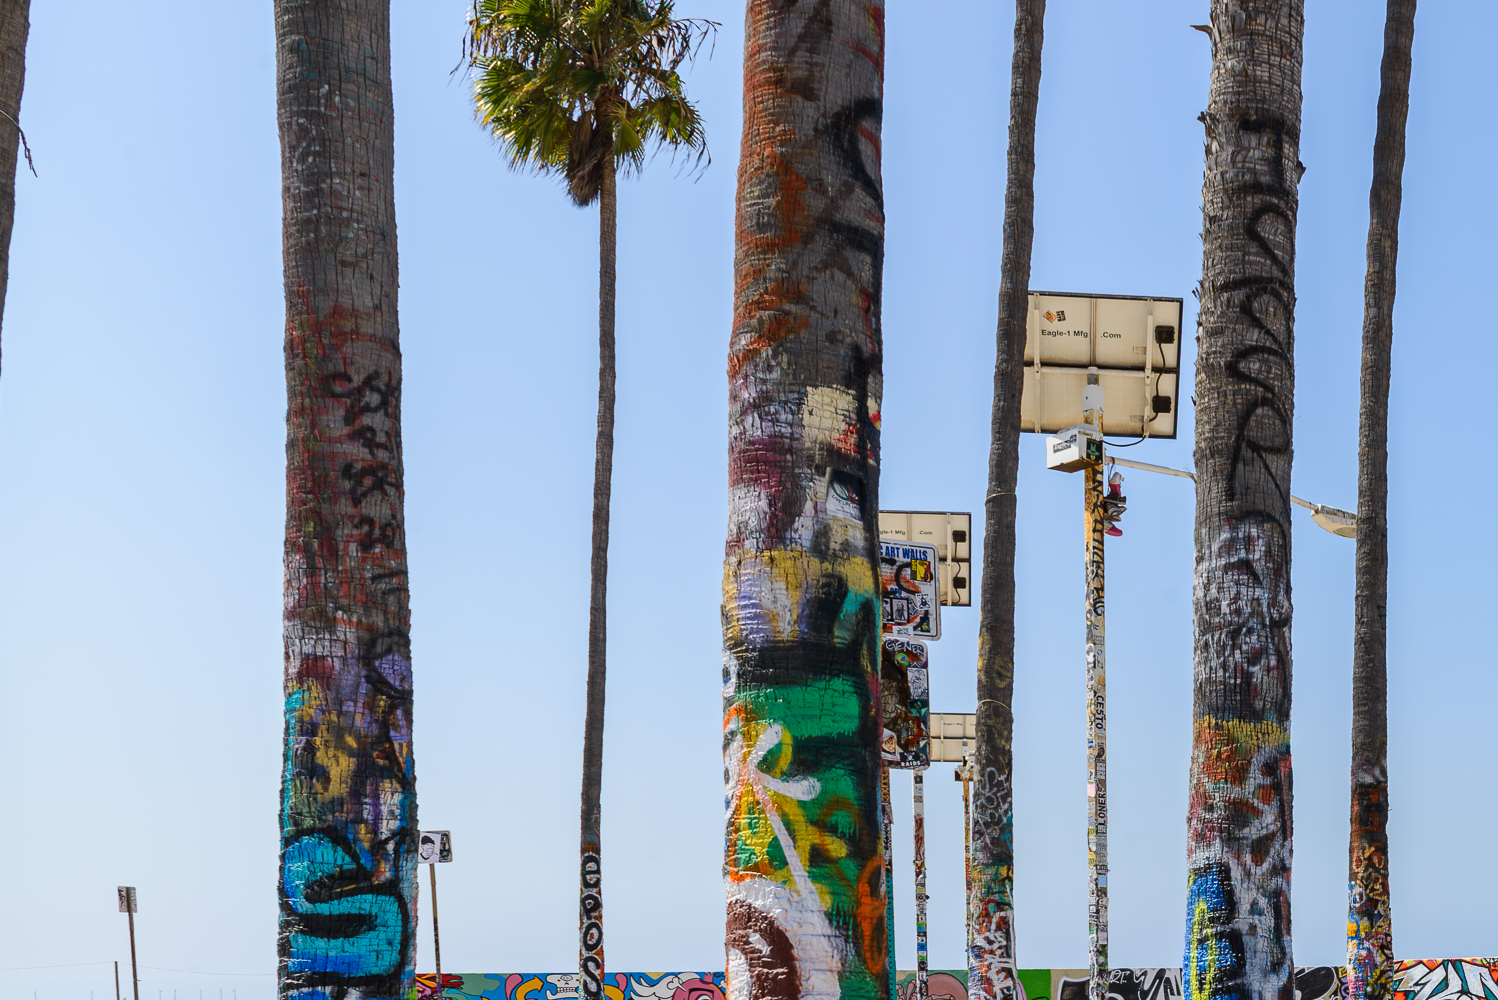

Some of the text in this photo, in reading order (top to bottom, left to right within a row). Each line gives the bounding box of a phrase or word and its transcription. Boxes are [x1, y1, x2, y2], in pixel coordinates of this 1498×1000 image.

[1041, 329, 1122, 339] Eagle-1 Mfg .Com
[885, 545, 900, 558] ART
[902, 547, 928, 561] WALLS
